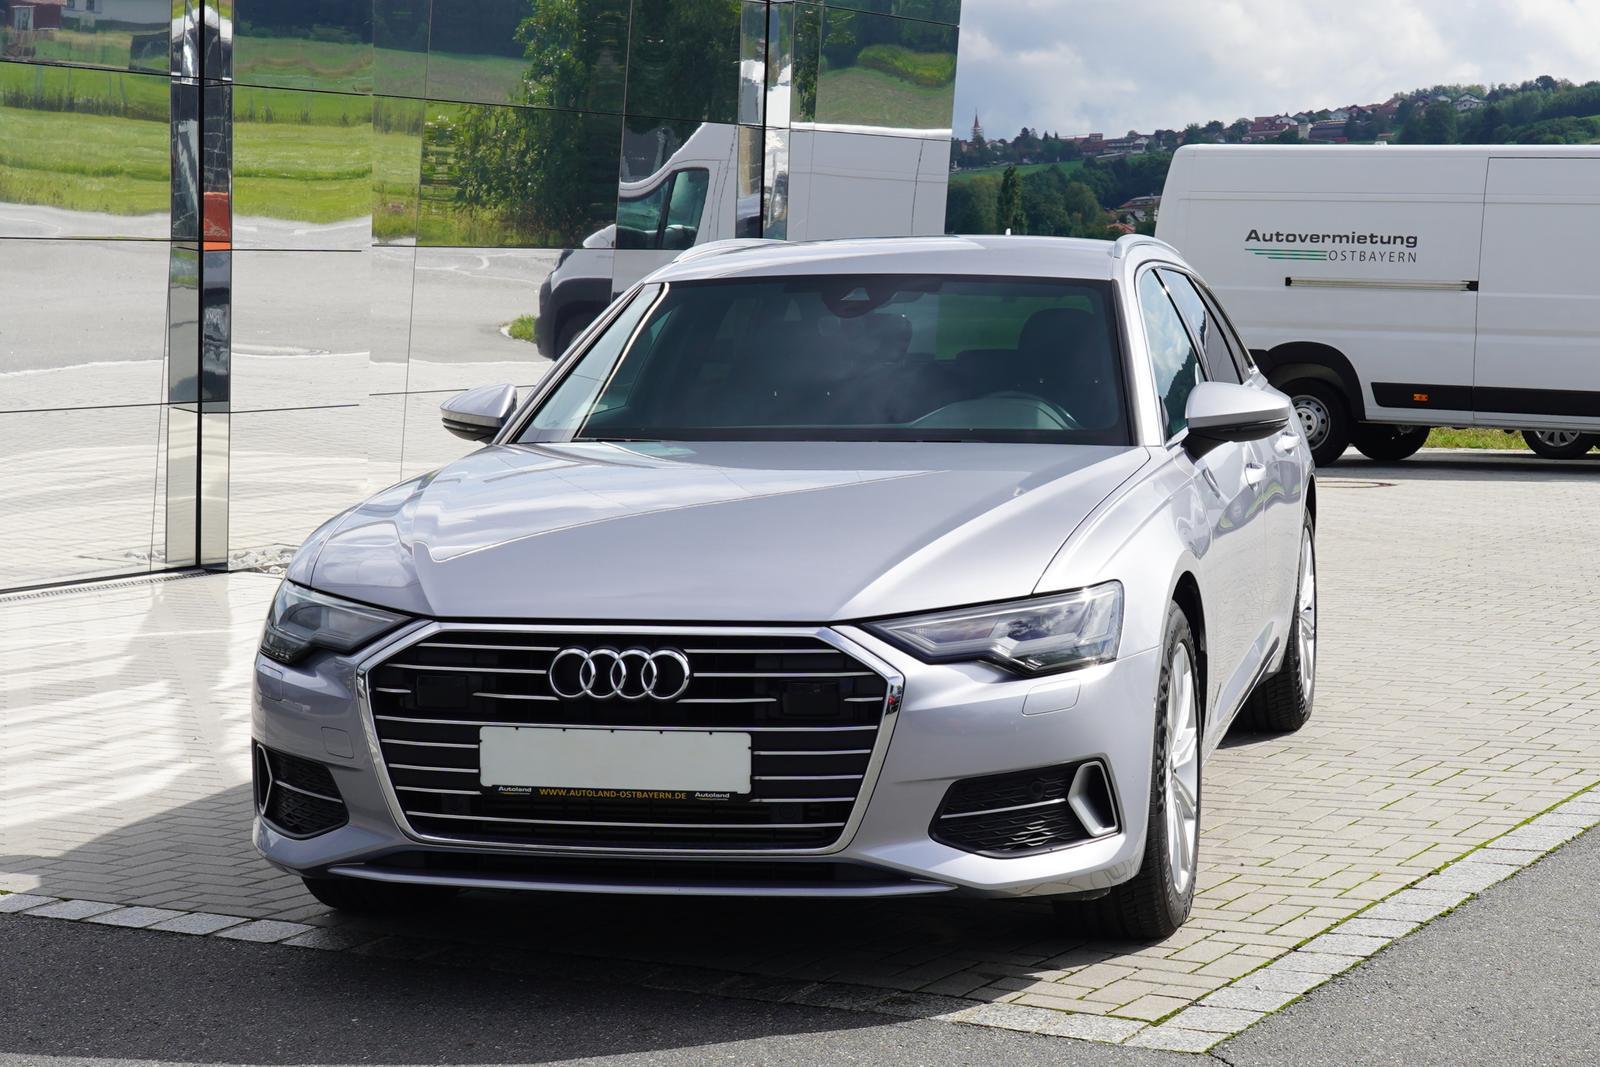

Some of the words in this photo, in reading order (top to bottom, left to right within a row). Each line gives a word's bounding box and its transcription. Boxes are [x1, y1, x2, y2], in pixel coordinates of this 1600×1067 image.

[1245, 229, 1418, 248] Autovermietung
[1328, 250, 1417, 263] OSTBAYERN
[539, 788, 687, 800] WWW.AUTOLAND-OSTBAYERN.DE
